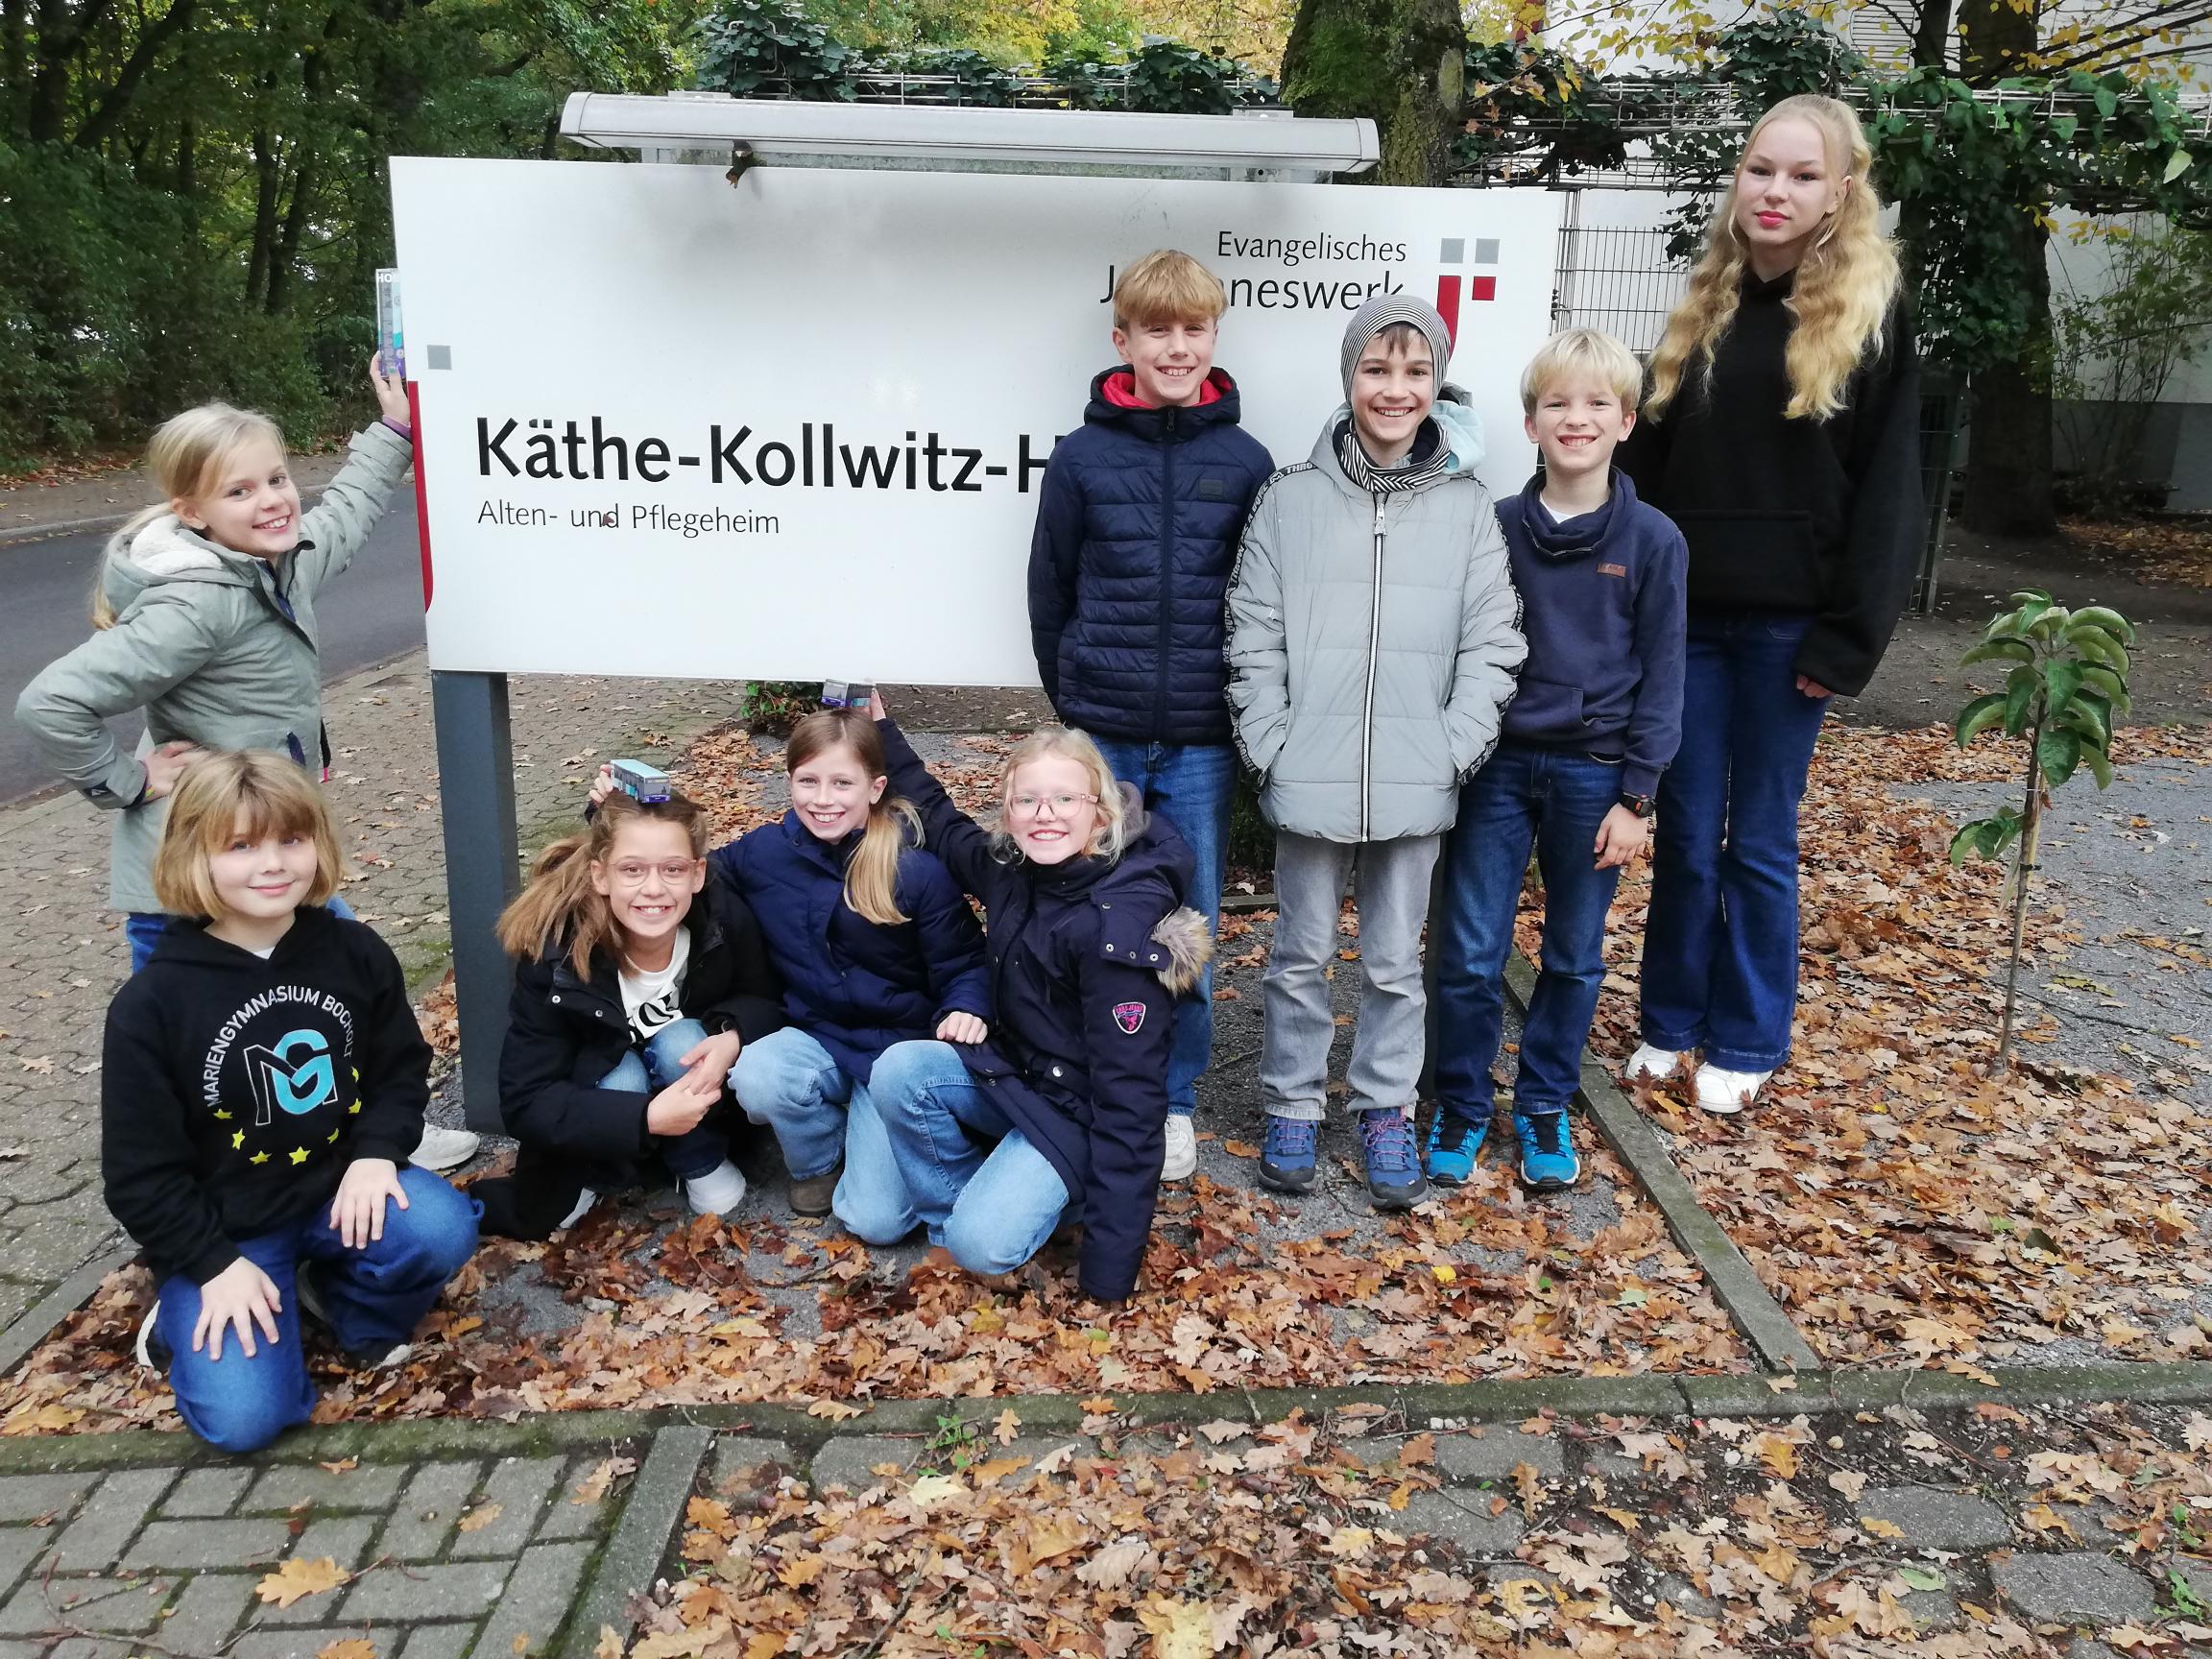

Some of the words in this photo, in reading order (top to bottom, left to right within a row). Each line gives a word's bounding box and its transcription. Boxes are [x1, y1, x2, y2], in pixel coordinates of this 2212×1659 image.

[1217, 230, 1407, 267] Evangelisches
[1099, 264, 1404, 310] Jneswerk
[476, 416, 1067, 493] Käthe-Kollwitz-H
[477, 498, 559, 528] Alten-
[570, 502, 621, 530] und
[632, 504, 781, 540] Pflegeheim
[202, 985, 321, 1108] MARIENGYMNASIUM
[321, 994, 354, 1058] BOCHOLT
